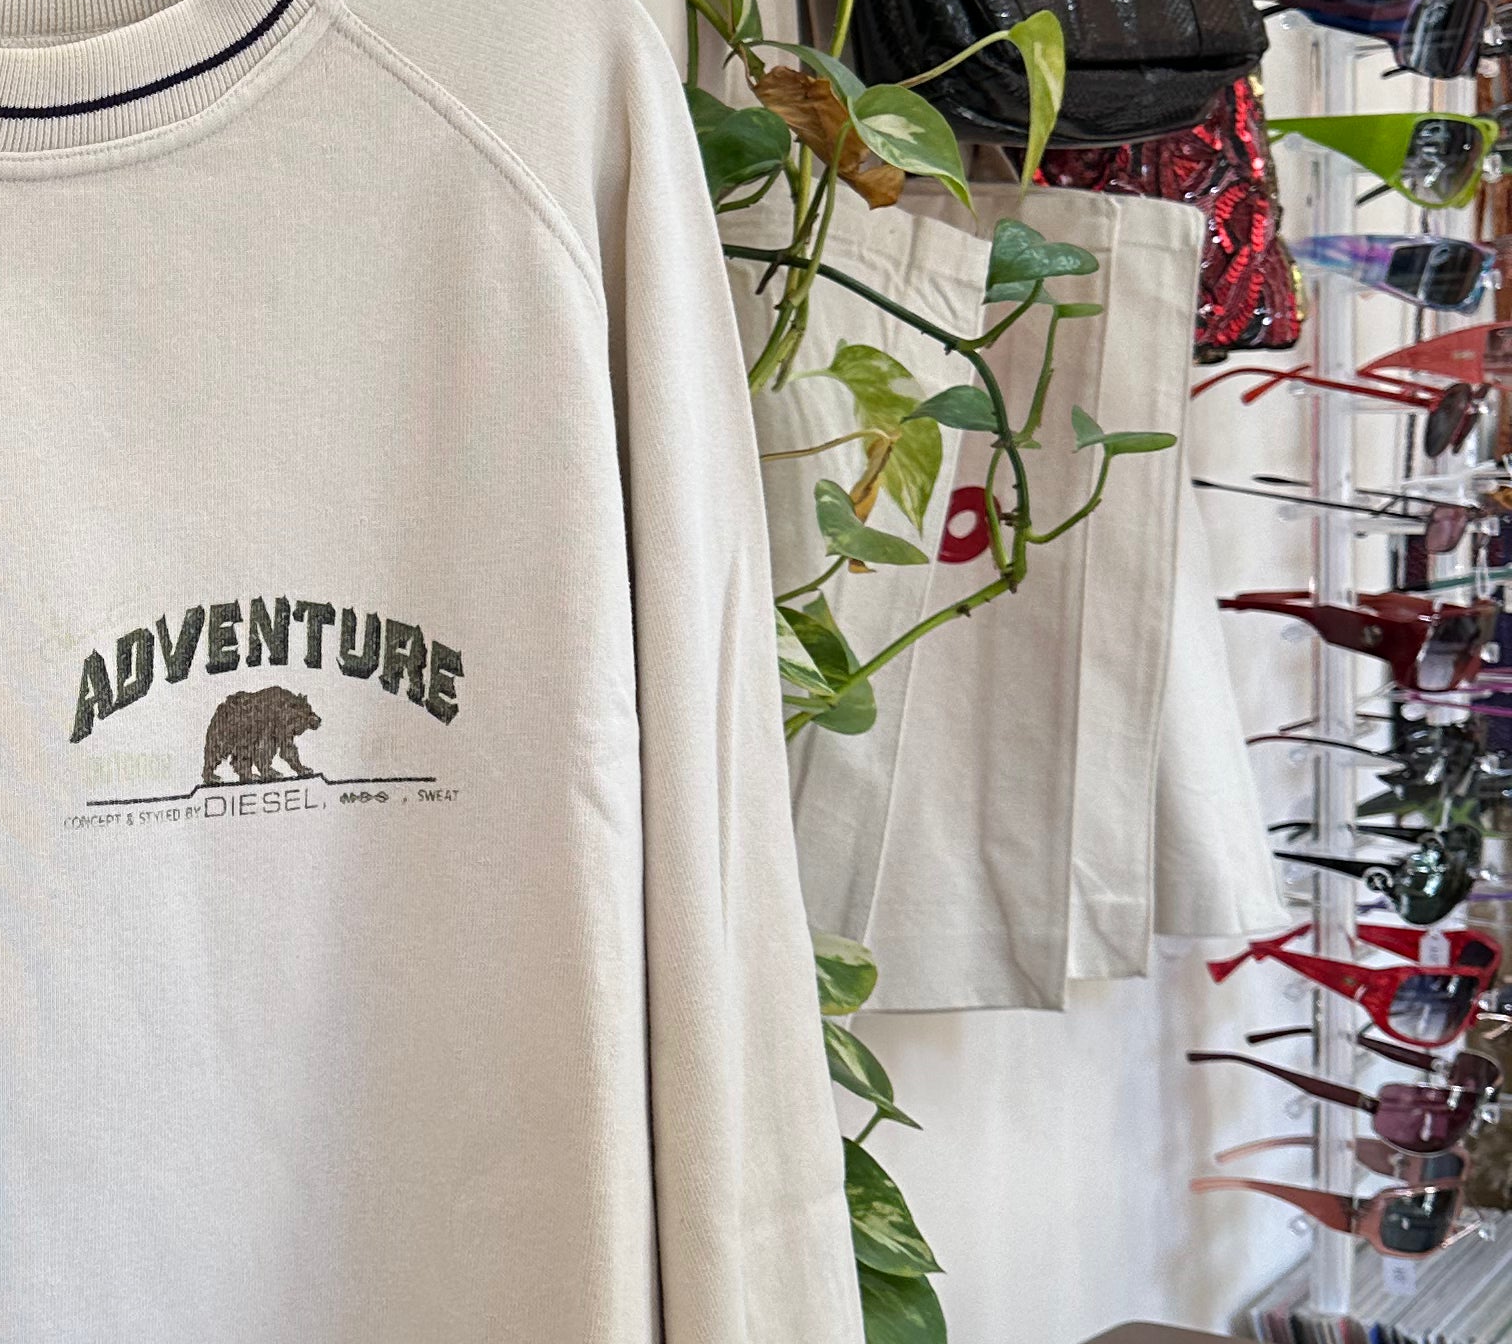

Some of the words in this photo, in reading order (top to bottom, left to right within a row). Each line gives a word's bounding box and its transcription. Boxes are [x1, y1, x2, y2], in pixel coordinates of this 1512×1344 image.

[69, 595, 465, 744] ADVENTURE
[185, 806, 201, 820] BY
[417, 788, 460, 803] SWEAT
